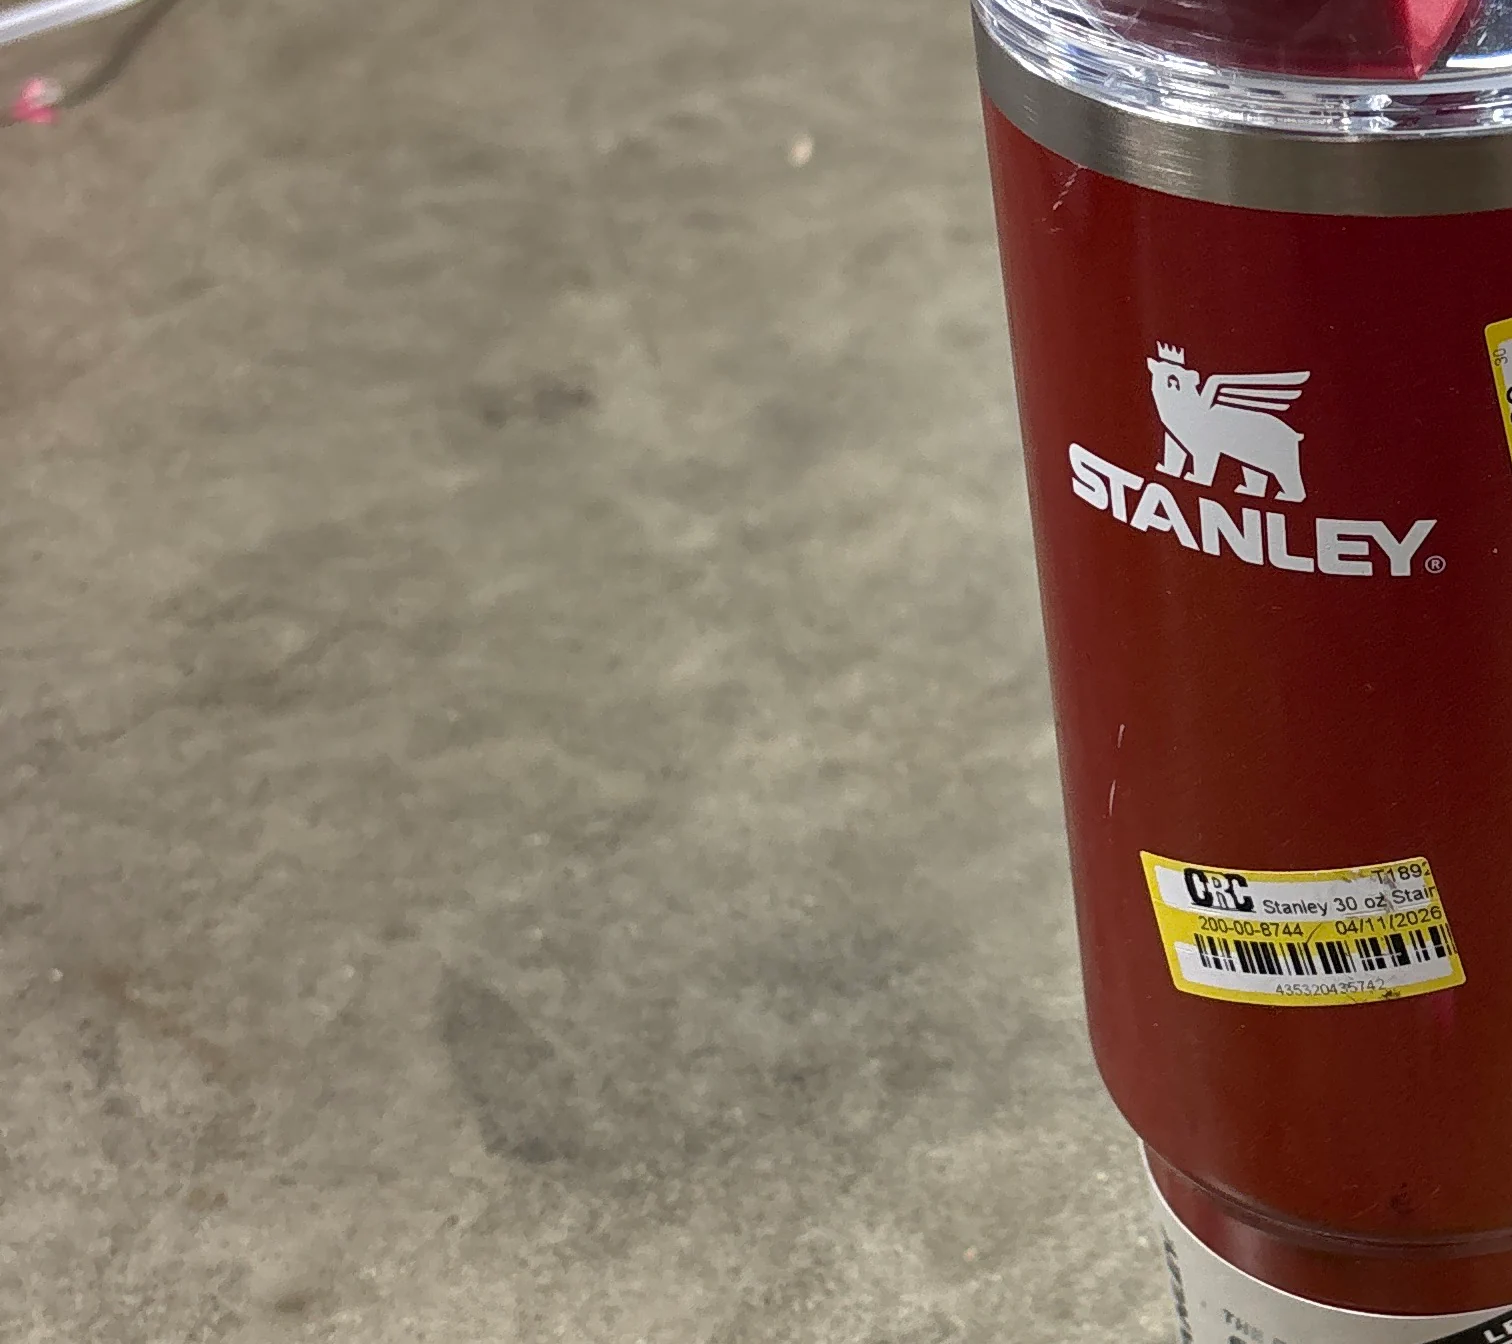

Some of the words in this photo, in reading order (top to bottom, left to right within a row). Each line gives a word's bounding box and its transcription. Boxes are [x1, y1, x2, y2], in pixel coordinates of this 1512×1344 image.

[1493, 347, 1508, 367] 30
[1068, 442, 1438, 577] STANLEY
[1184, 867, 1256, 913] CRC
[1262, 899, 1328, 917] Stanley
[1334, 896, 1358, 913] 30
[1364, 893, 1388, 909] oz
[1199, 916, 1304, 937] 200-00-8744
[1335, 905, 1442, 935] 04/11/2026
[1223, 1308, 1264, 1344] THE
